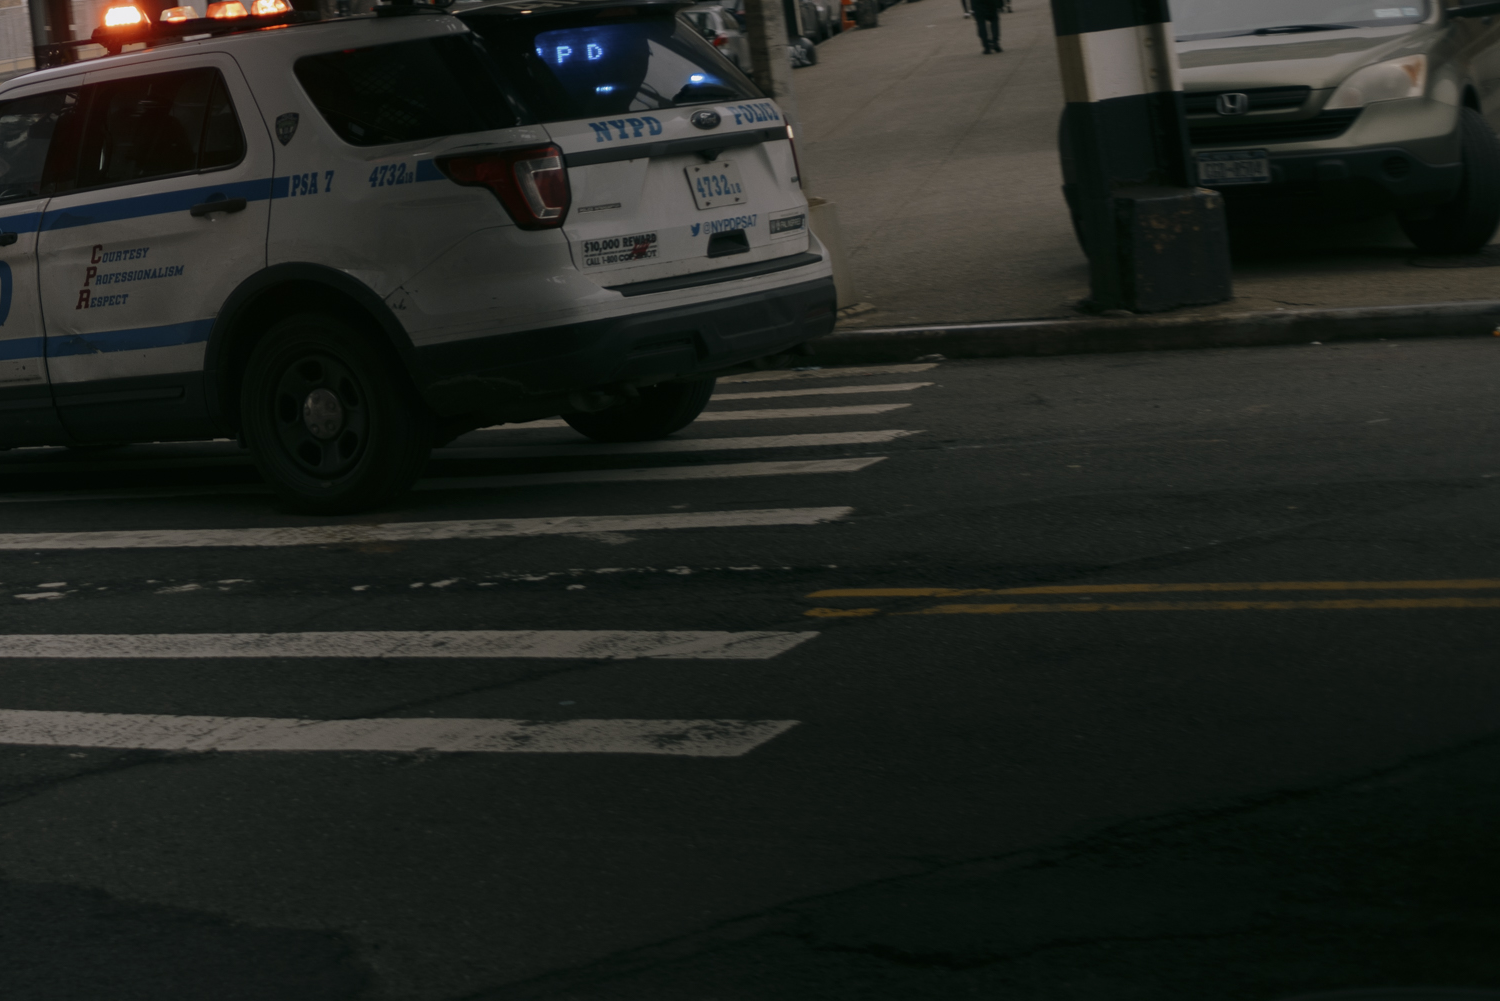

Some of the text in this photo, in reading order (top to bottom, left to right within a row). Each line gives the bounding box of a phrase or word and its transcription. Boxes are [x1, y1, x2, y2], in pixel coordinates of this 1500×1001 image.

[588, 116, 663, 143] NYPD
[290, 170, 335, 197] PSA 7
[702, 213, 758, 236] @NYPDPSA7
[90, 244, 150, 265] COURTESY
[583, 238, 620, 253] $10,000
[622, 233, 657, 247] REWARD
[586, 256, 601, 267] CALL
[83, 264, 185, 287] PROFESSIONALISM
[75, 288, 130, 311] RESPECT
